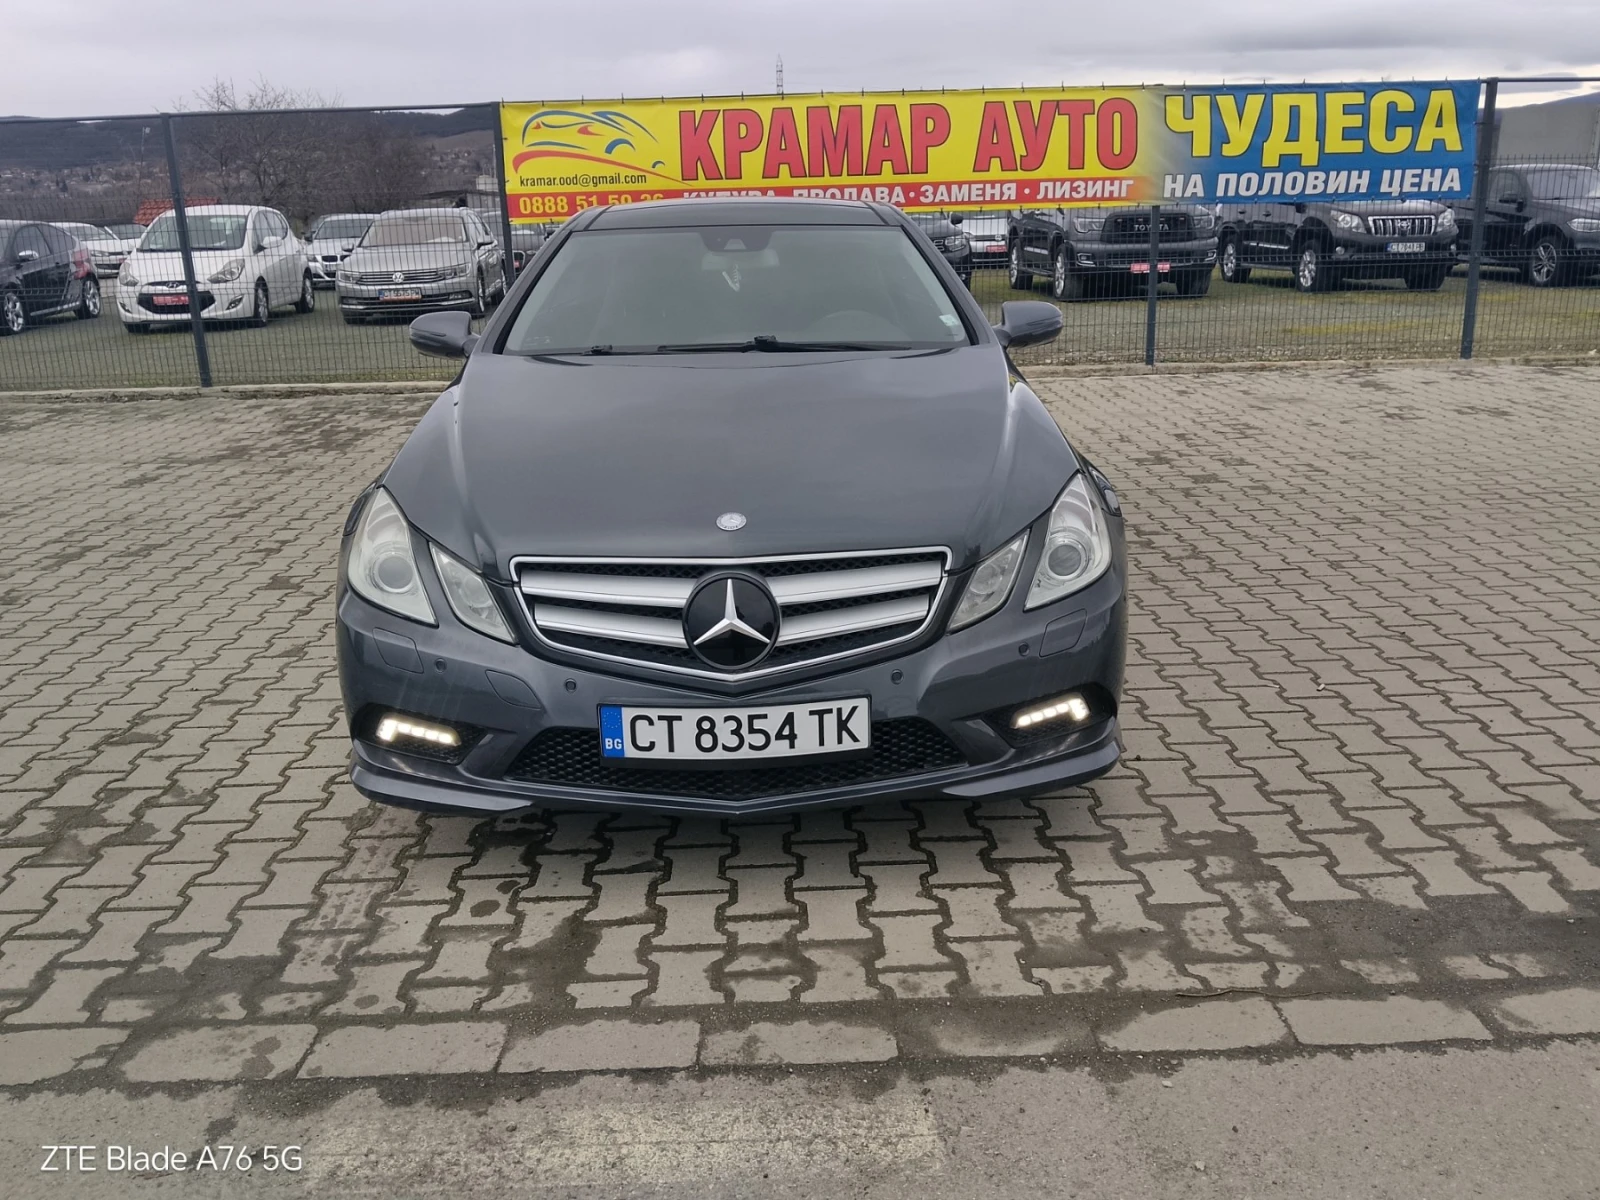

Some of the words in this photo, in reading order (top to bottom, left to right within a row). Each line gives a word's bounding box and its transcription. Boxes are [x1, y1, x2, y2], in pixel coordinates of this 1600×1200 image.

[679, 103, 951, 181] КРАМАР
[973, 97, 1138, 172] АУТО
[1164, 89, 1463, 168] ЧУДЕСА
[519, 173, 647, 188] kramar.ood@gmail.com
[919, 182, 1017, 203] ЗАМЕНЯ
[1036, 180, 1134, 200] ЛИЗИНГ
[1163, 174, 1205, 198] НА
[1215, 170, 1370, 197] ПОЛОВИН
[1379, 168, 1461, 196] ЦЕНА
[519, 195, 568, 214] 0888
[629, 714, 683, 752] CT
[695, 712, 797, 753] 8354
[809, 706, 860, 746] TK
[605, 738, 622, 749] BG
